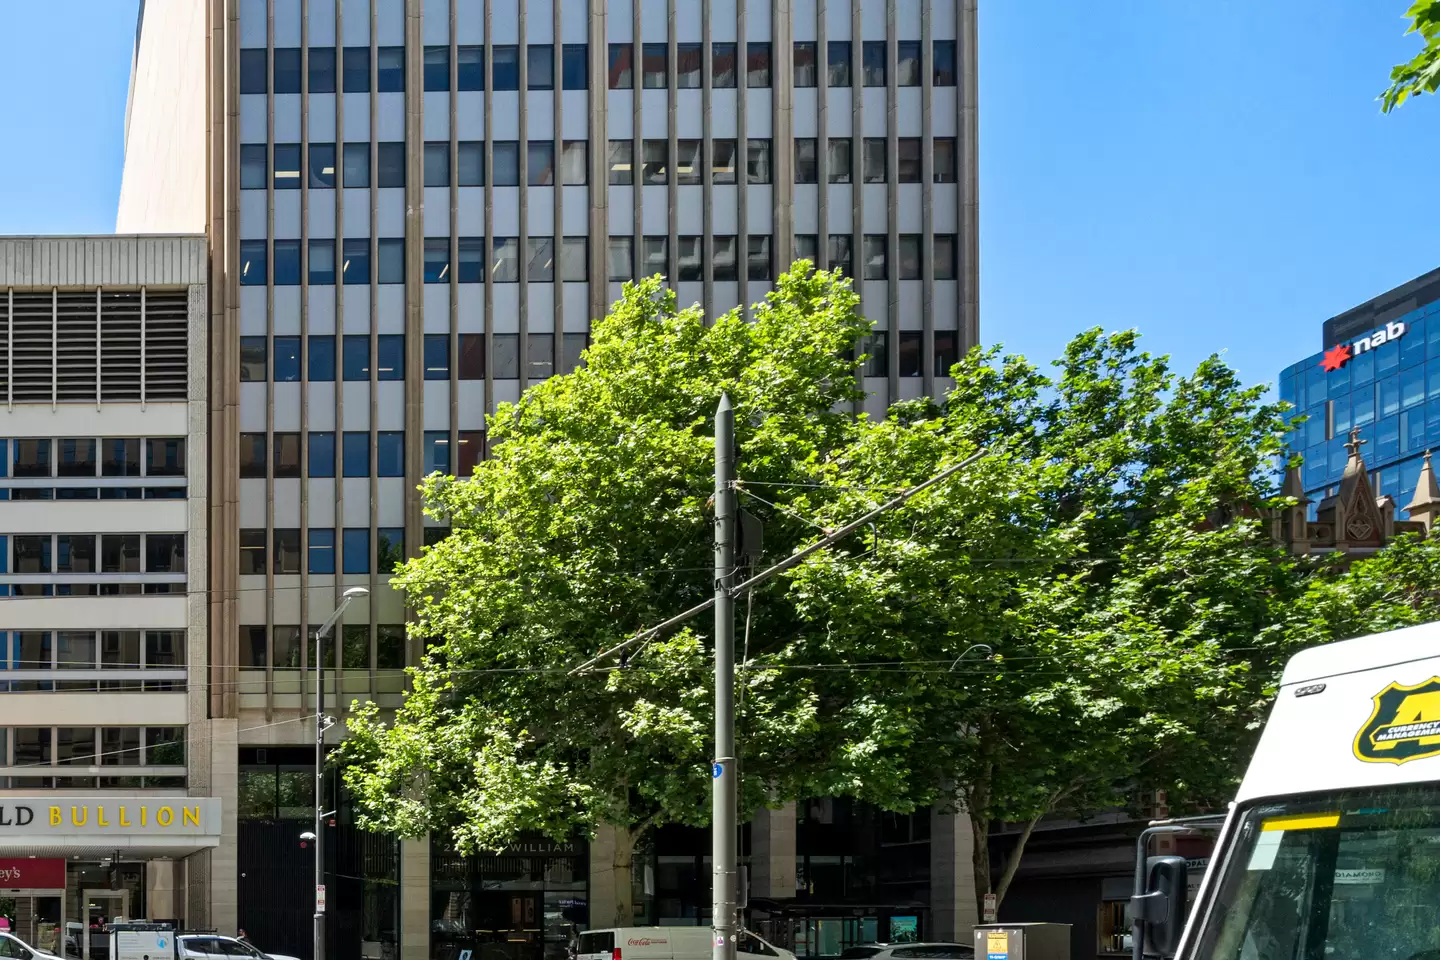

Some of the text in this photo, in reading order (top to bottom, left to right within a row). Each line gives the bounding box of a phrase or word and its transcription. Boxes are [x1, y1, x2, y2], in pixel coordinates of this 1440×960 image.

[1353, 321, 1405, 355] nab
[1387, 721, 1440, 733] CURRENCY
[49, 806, 201, 827] BULLION
[510, 843, 574, 852] WILLIAM
